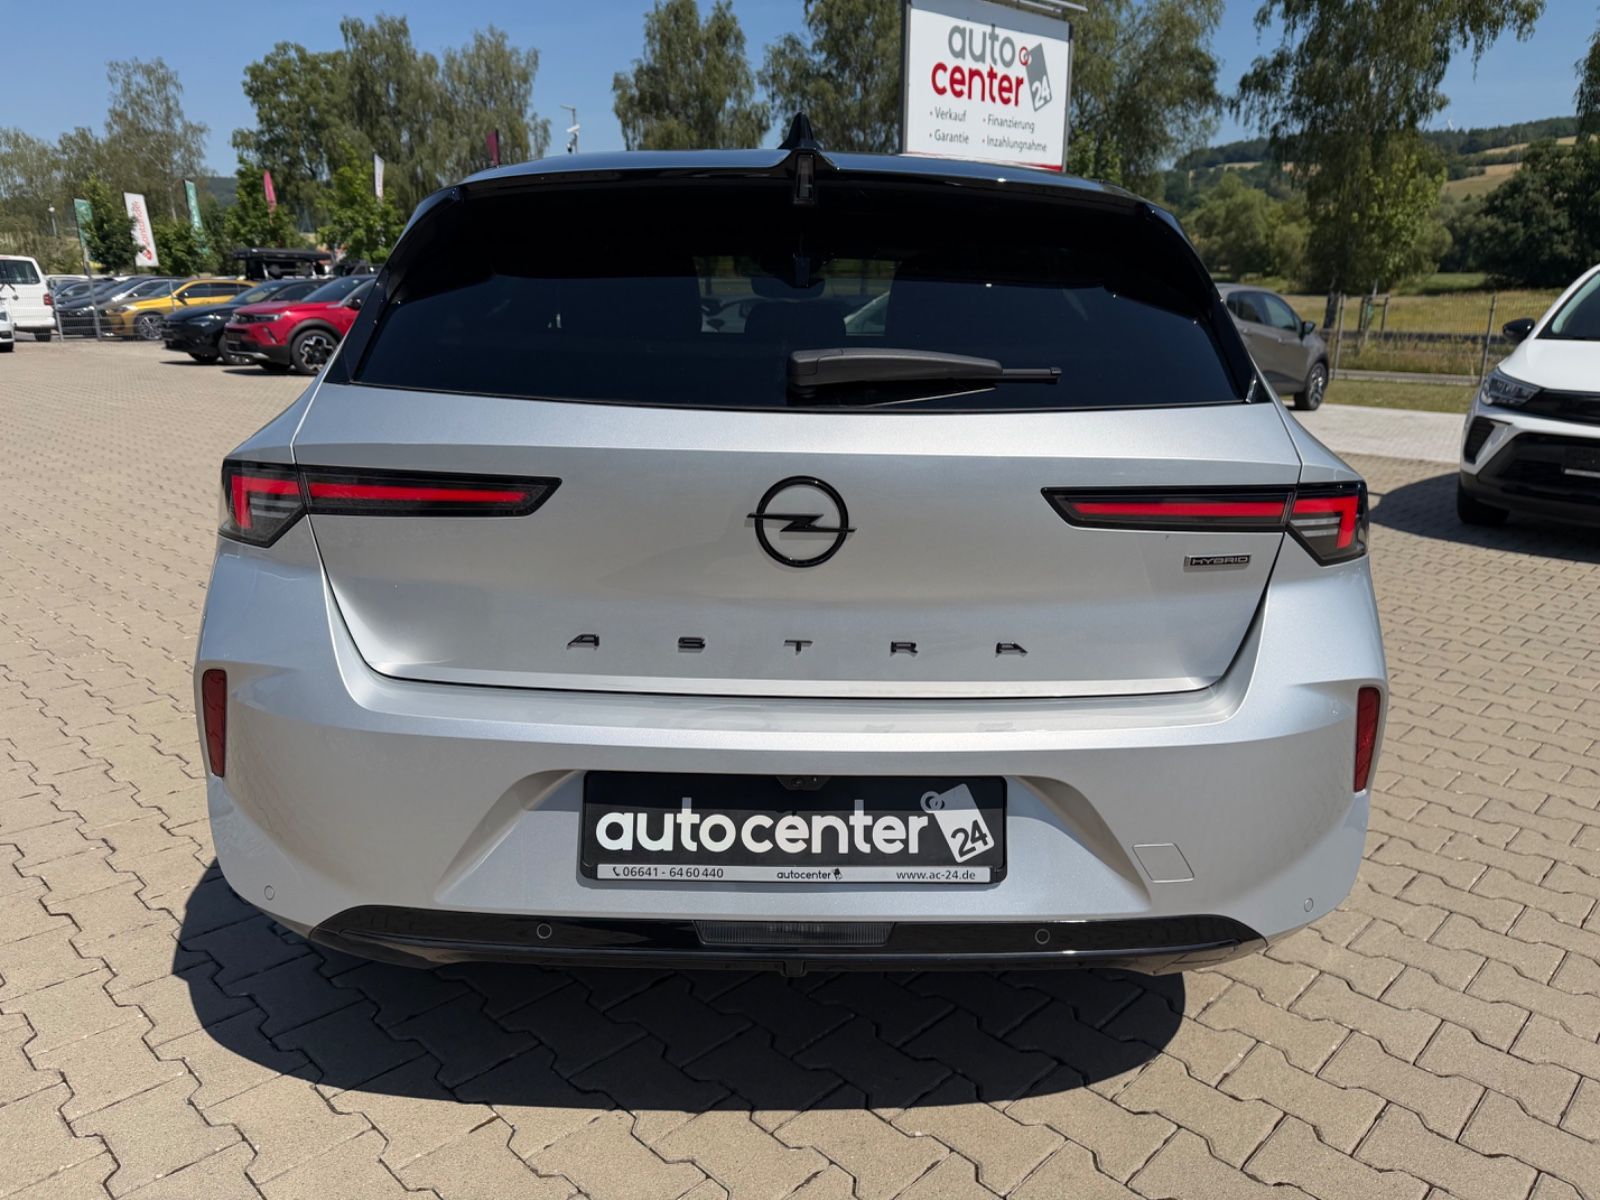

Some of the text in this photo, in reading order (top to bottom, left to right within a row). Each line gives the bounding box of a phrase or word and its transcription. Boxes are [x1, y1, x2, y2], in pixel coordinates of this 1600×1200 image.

[948, 24, 1016, 68] auto
[931, 62, 1024, 107] center
[1031, 76, 1051, 107] 24
[934, 107, 967, 122] Verkauf
[987, 114, 1035, 134] Finanzierung
[934, 129, 969, 145] Garantie
[986, 136, 1047, 152] Inzahlungnahme
[1192, 557, 1248, 565] HYBRID
[567, 634, 1028, 655] ASTRA
[595, 797, 989, 858] autocenter 24
[622, 866, 658, 877] 06641
[776, 869, 832, 880] autocenter
[896, 870, 976, 880] www.ac-24.de
